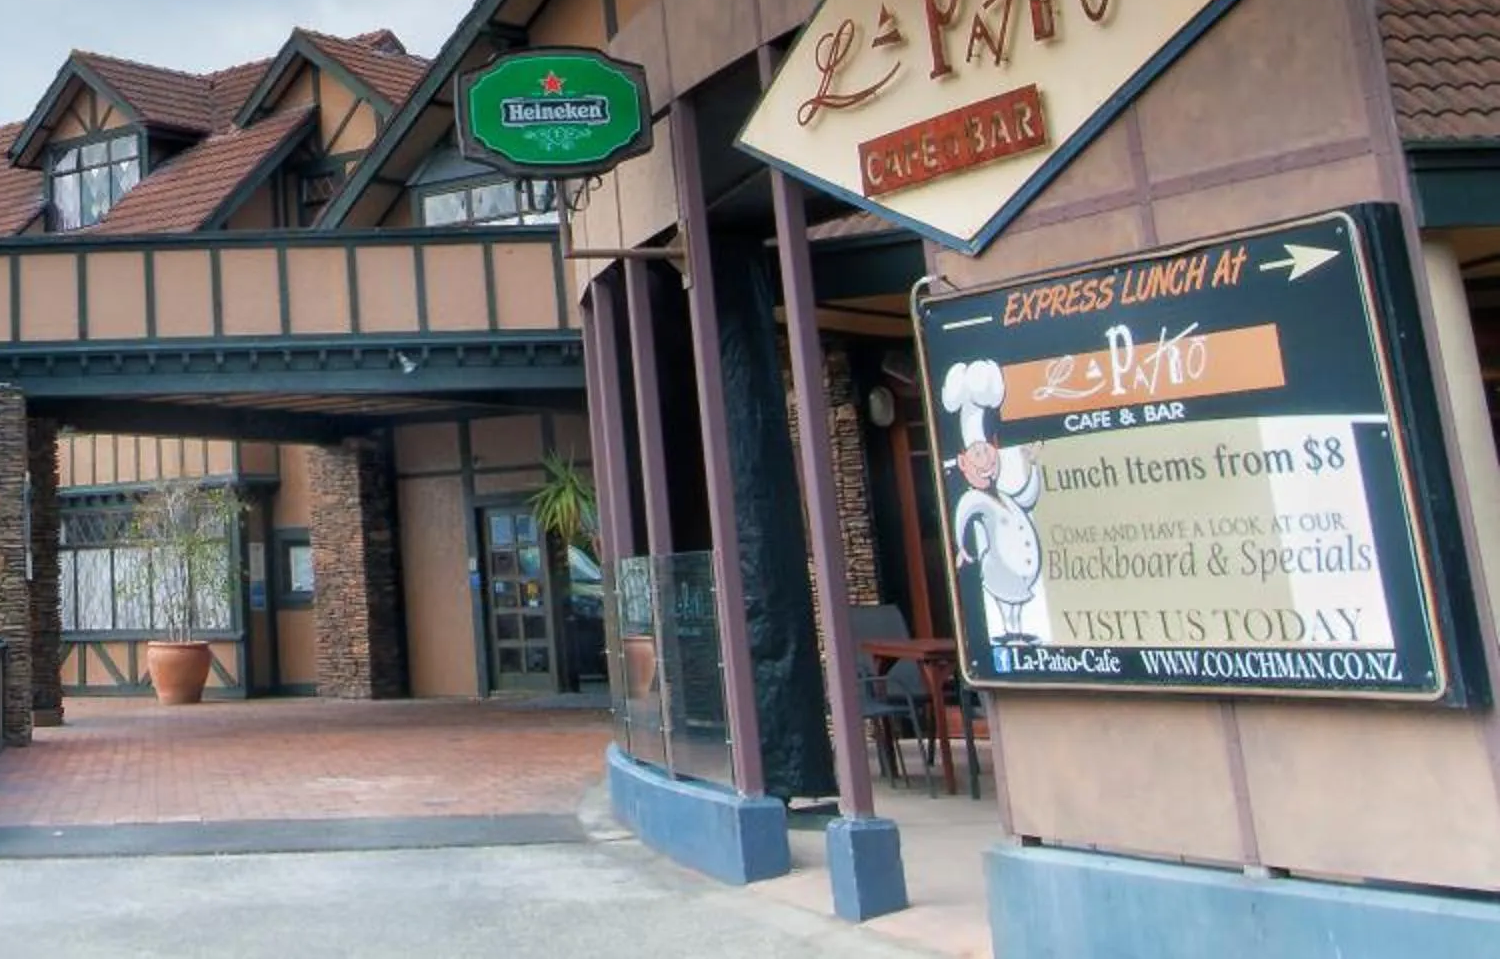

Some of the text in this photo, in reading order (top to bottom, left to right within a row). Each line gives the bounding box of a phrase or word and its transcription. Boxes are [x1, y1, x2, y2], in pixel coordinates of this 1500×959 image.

[508, 103, 602, 121] Heineken
[1004, 276, 1116, 326] EXPRESS
[1121, 254, 1208, 305] LUNCH
[1064, 402, 1185, 432] CAFE & BAR
[1042, 435, 1345, 492] Lunch Items from $8
[1102, 522, 1138, 542] AND
[1141, 519, 1188, 540] HAVE
[1192, 519, 1205, 538] A
[1208, 515, 1263, 538] LOOK
[1270, 515, 1293, 532] AT
[1299, 511, 1348, 532] OUR
[1047, 534, 1373, 584] Blackboard & Specials
[1062, 607, 1362, 642] VISIT US TODAY
[1139, 649, 1402, 682] WWW.COACHMAN.CO.NZ
